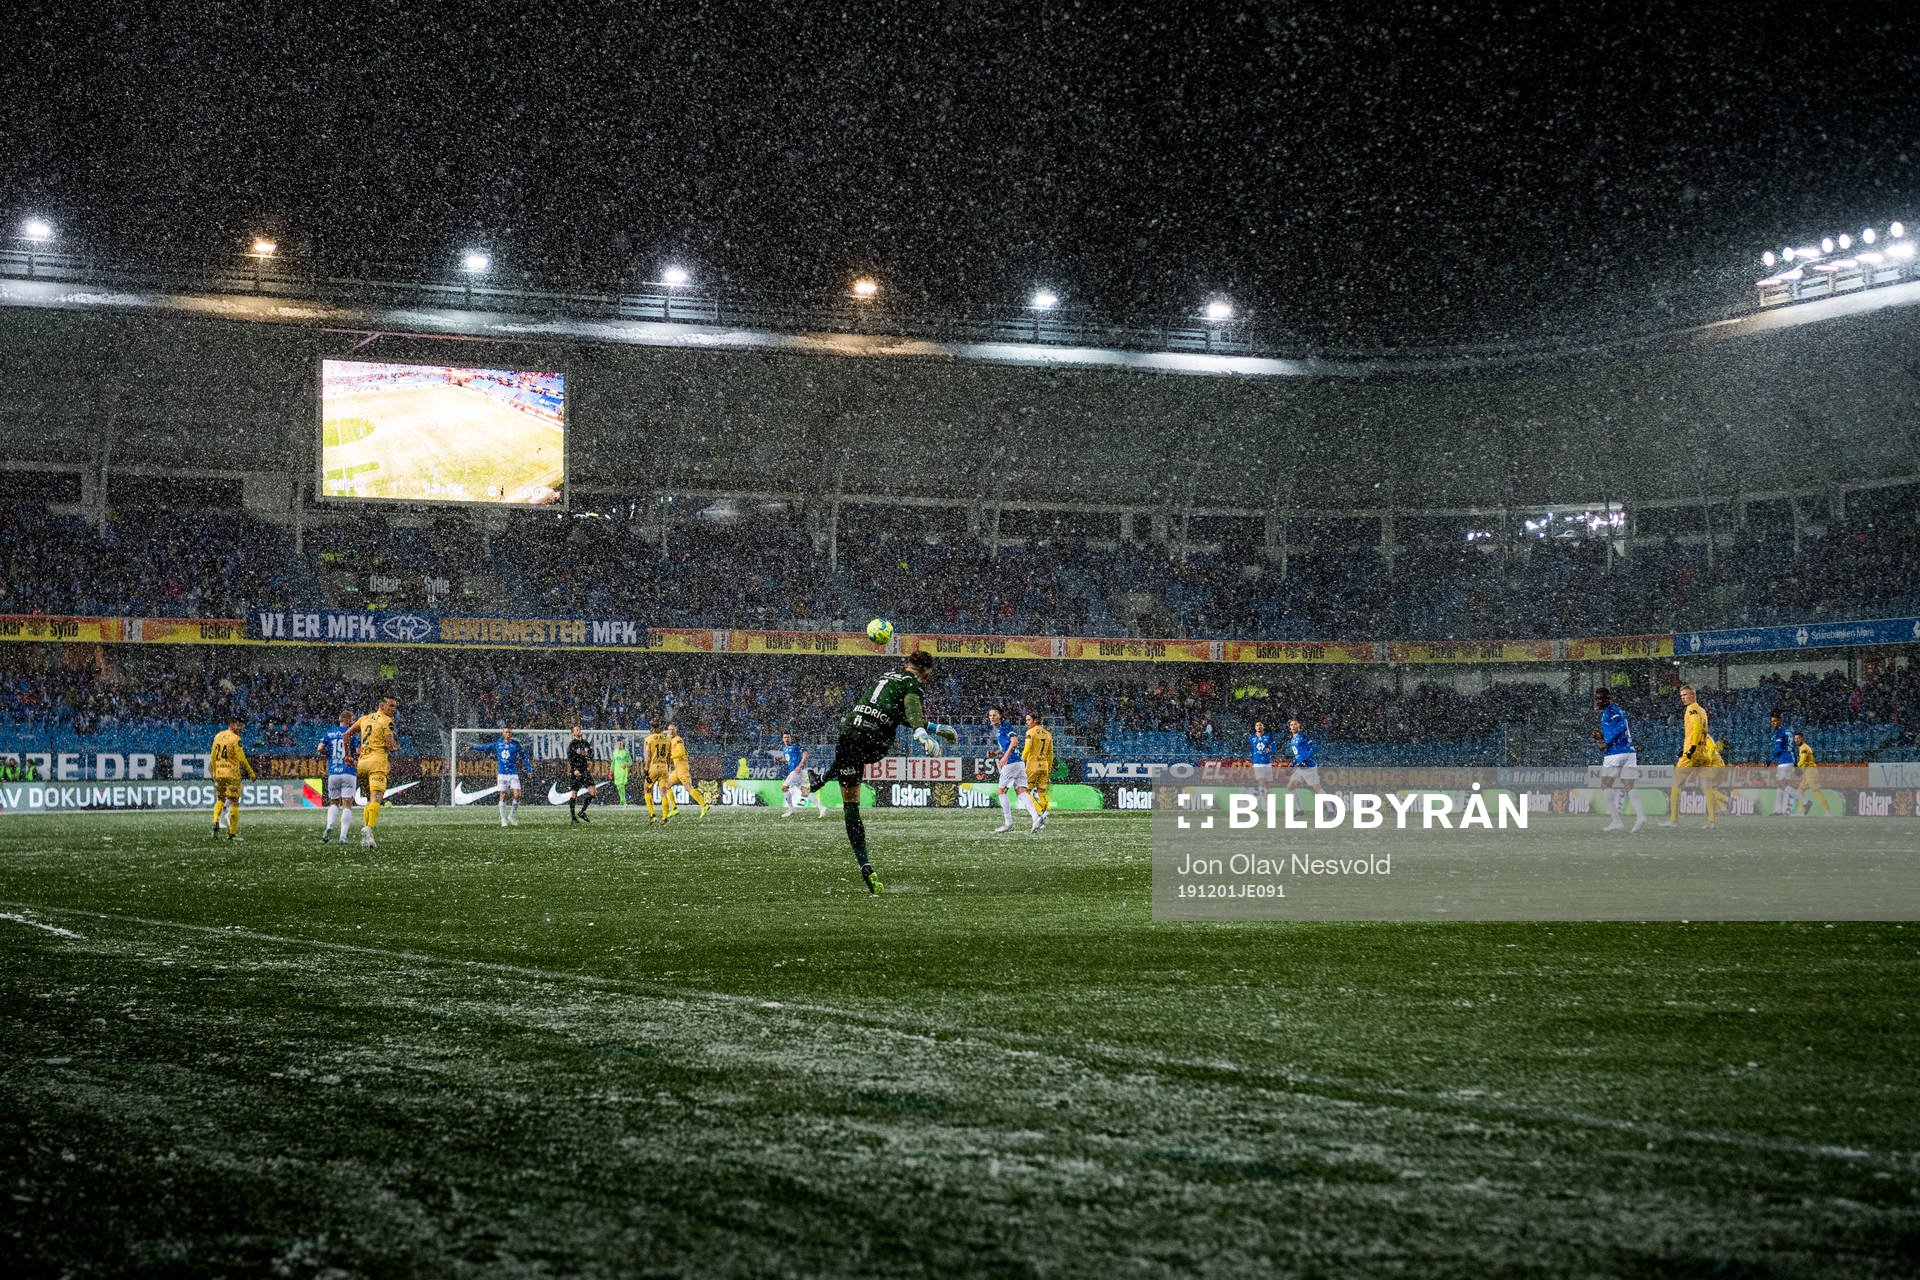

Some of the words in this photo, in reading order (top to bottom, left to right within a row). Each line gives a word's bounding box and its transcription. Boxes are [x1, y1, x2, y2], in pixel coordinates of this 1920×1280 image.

[259, 613, 285, 637] VI
[292, 614, 320, 638] ER
[328, 615, 377, 639] MFK
[439, 617, 586, 643] SERIEMESTER
[592, 620, 637, 644] MFK
[1811, 629, 1856, 641] Sparebanken
[870, 679, 889, 704] 1
[215, 743, 229, 761] 24
[331, 738, 347, 760] 19
[908, 759, 956, 779] TIBE
[1087, 762, 1195, 778] MIFO
[1648, 770, 1673, 779] BIL
[1880, 764, 1920, 786] Vike
[891, 783, 932, 807] Oskar
[958, 784, 990, 809] Sylte
[1118, 787, 1155, 809] Oskar
[1680, 790, 1707, 814] Oska
[1858, 791, 1892, 816] Oskar
